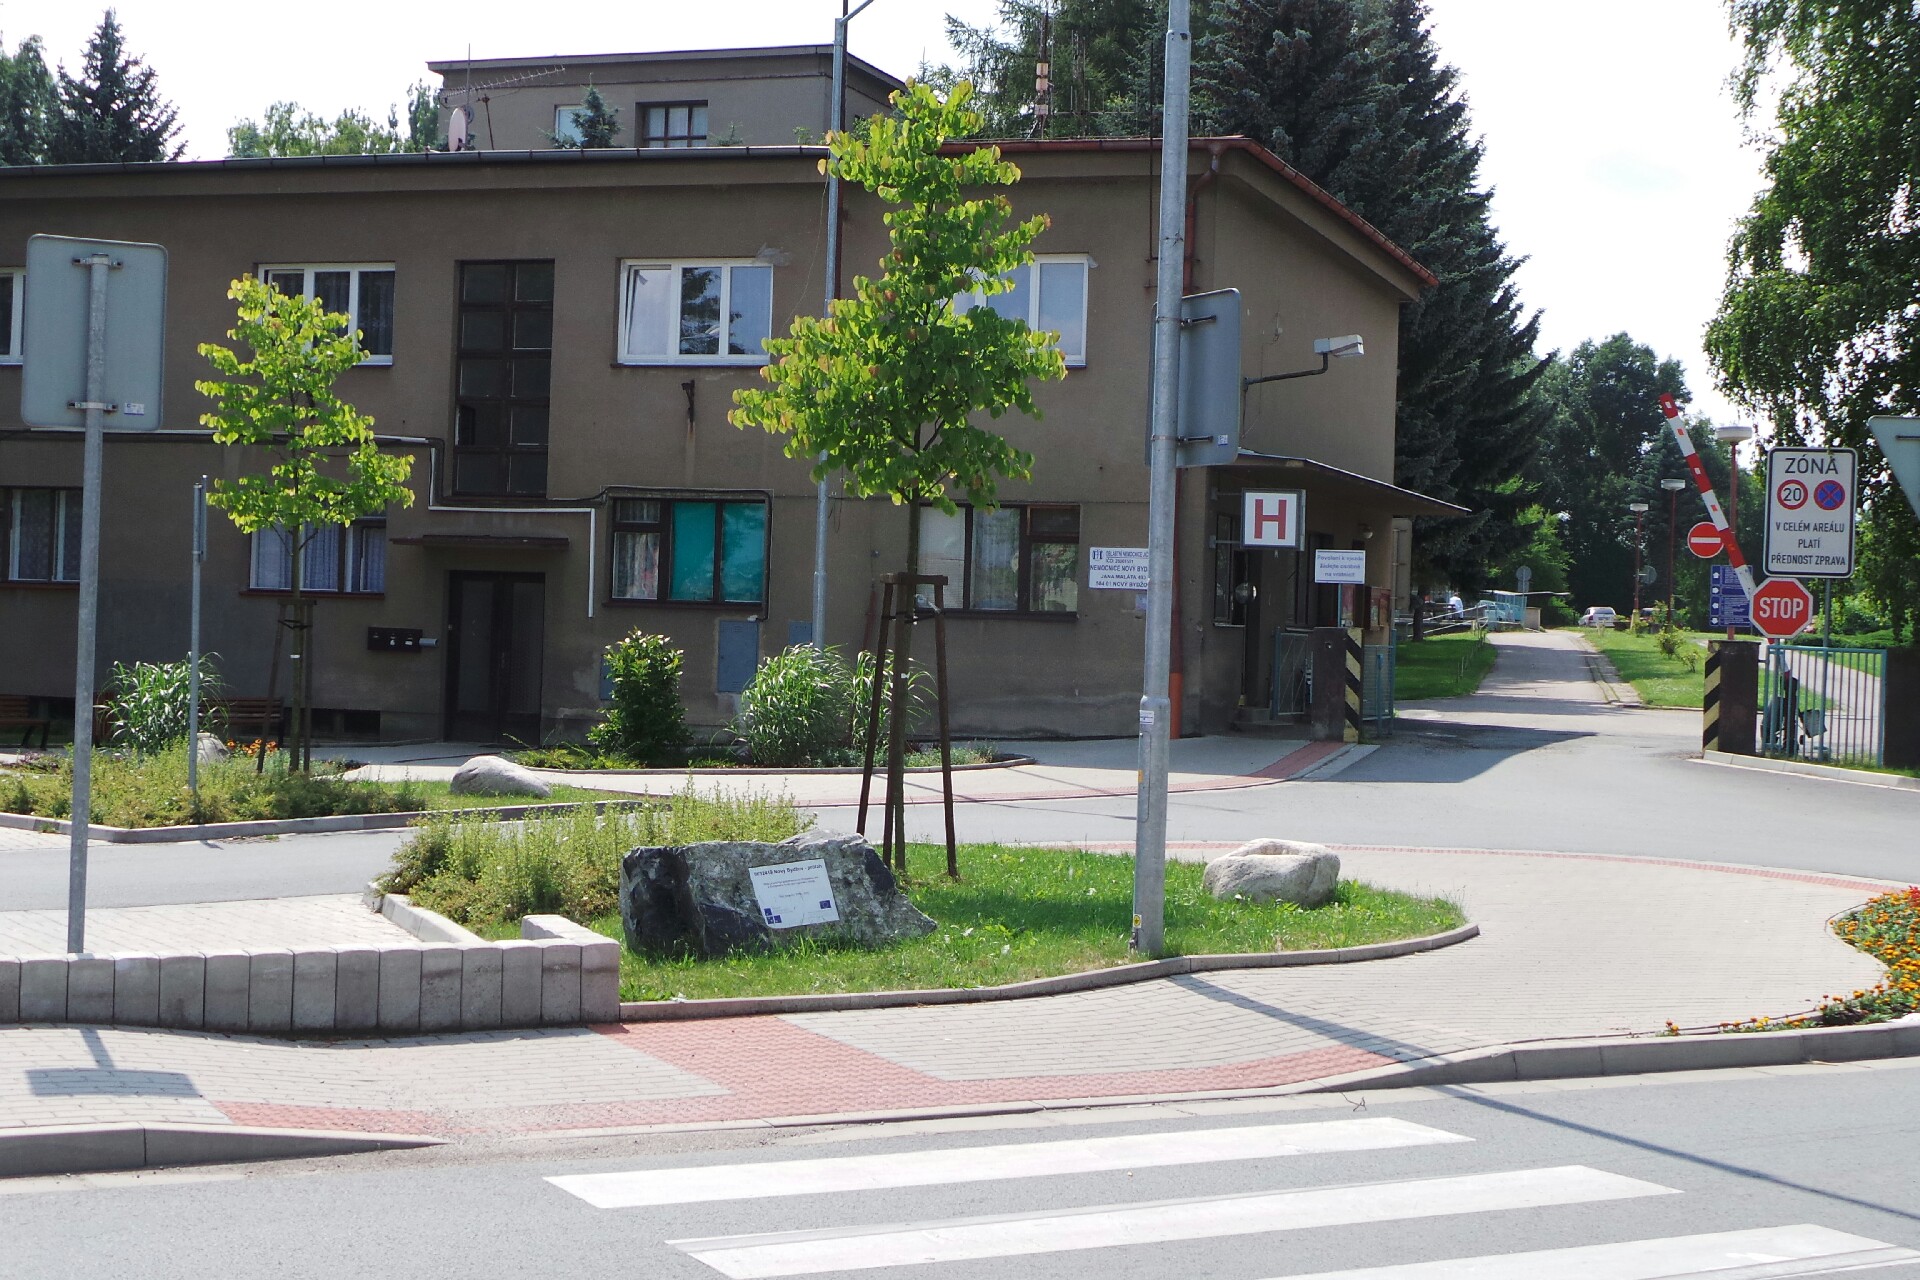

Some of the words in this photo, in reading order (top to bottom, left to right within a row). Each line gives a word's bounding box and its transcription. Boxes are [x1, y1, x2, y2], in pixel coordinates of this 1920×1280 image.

[1784, 454, 1838, 474] ZÓNA
[1783, 487, 1802, 501] 20
[1254, 499, 1287, 540] H
[1775, 522, 1781, 531] V
[1783, 520, 1810, 532] CELÉM
[1812, 521, 1845, 532] AREÁLU
[1797, 537, 1821, 549] PLATÍ
[1771, 553, 1813, 565] PŘEDNOST
[1815, 556, 1846, 566] ZPRAVA
[1759, 597, 1804, 619] STOP
